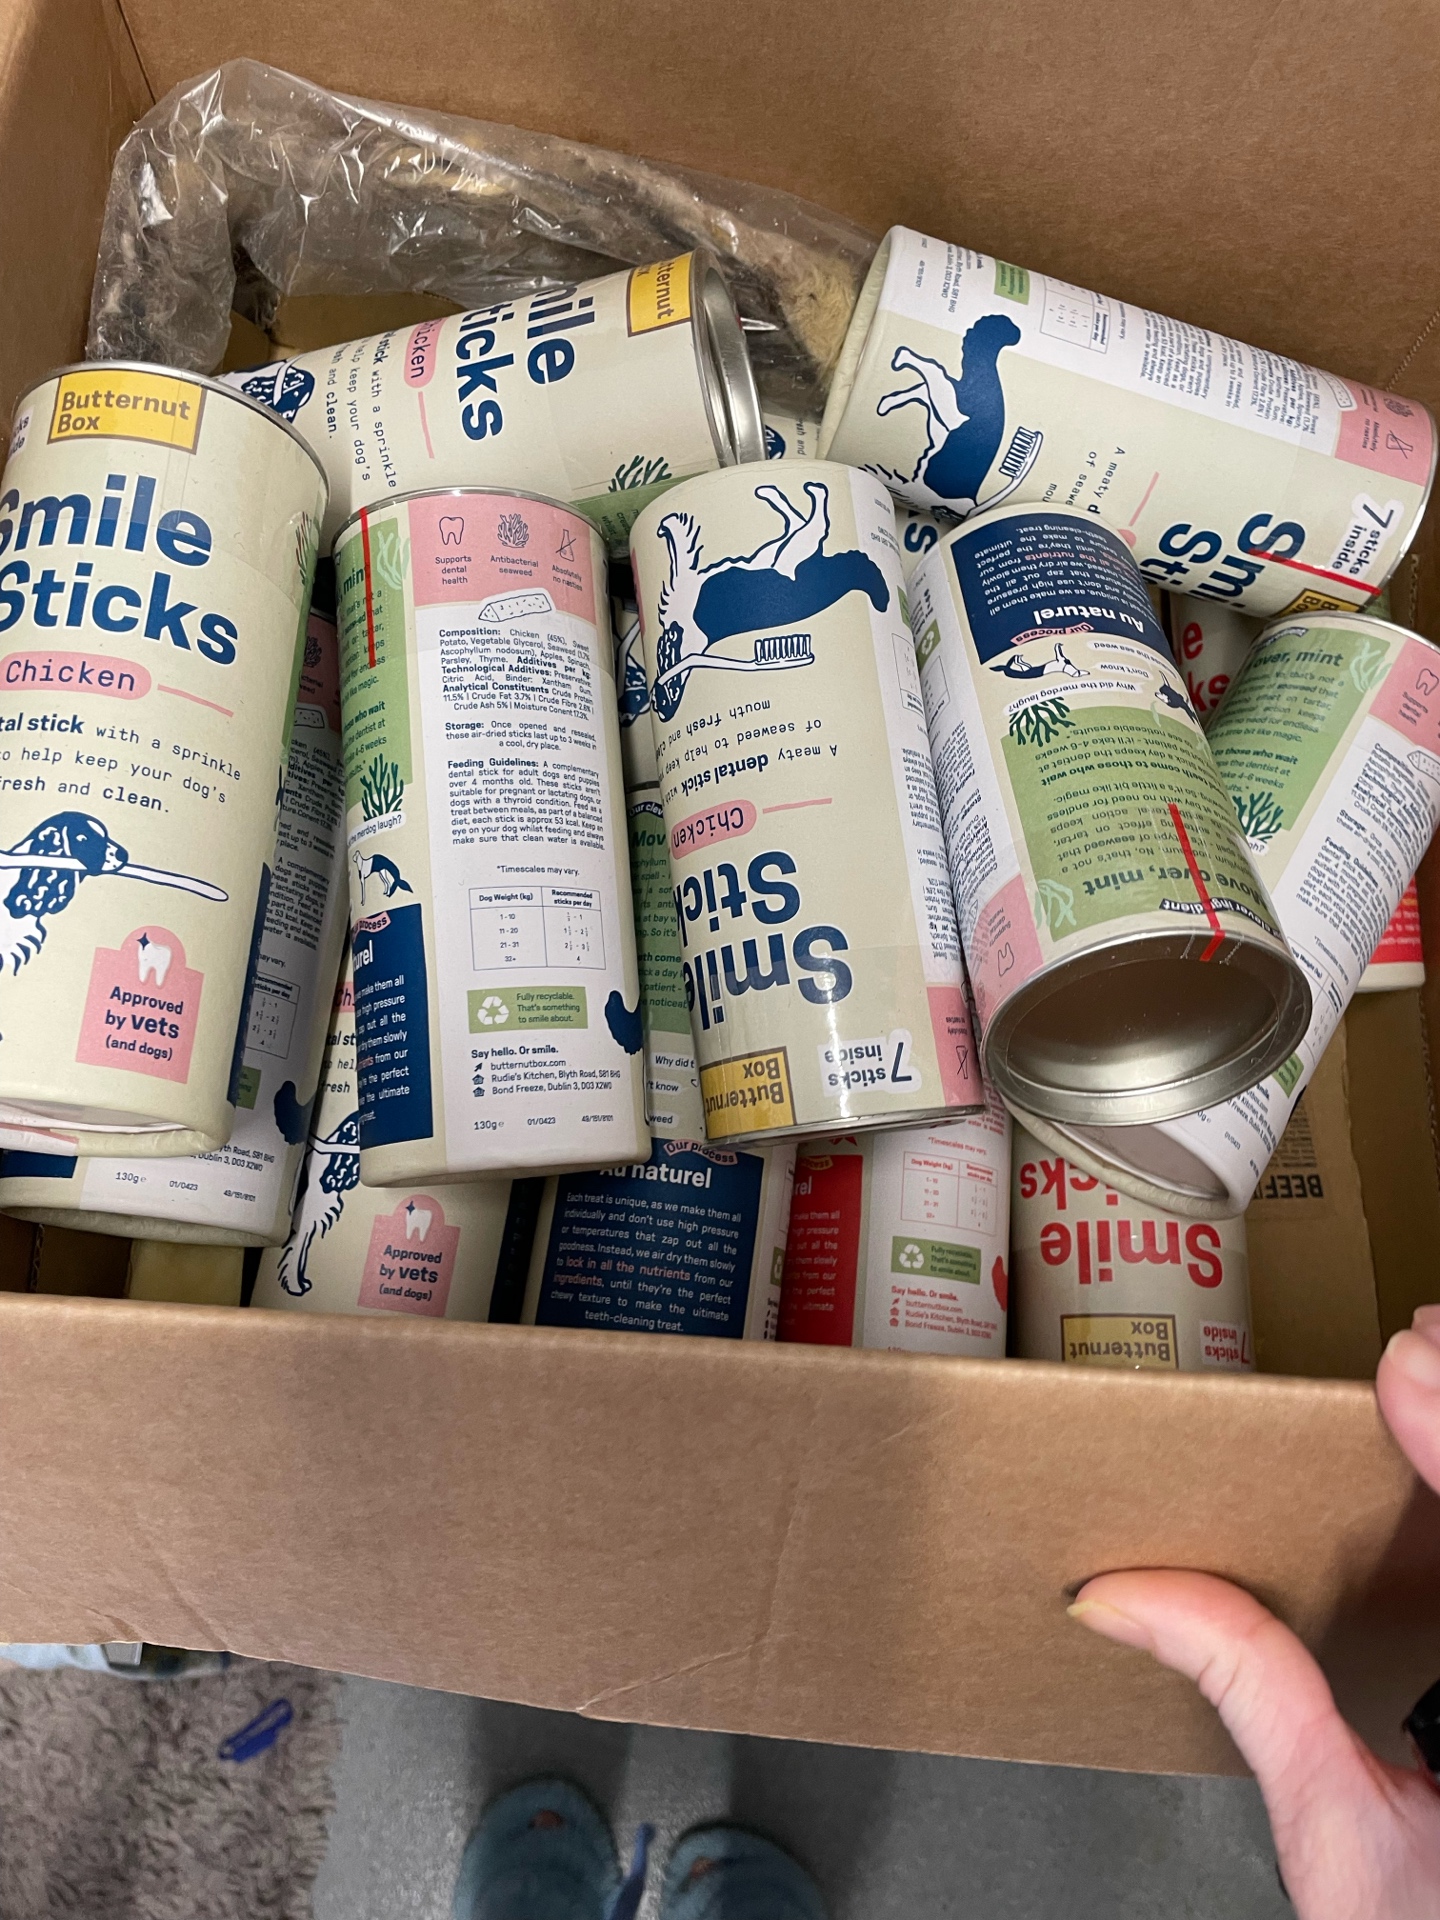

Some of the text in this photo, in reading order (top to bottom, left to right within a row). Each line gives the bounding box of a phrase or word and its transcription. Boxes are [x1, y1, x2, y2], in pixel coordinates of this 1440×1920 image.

[61, 390, 191, 420] Butternut
[57, 414, 100, 433] Box
[326, 392, 337, 439] clean.
[348, 367, 370, 481] keep your dog's
[371, 370, 396, 488] with sprinkle
[1094, 446, 1125, 499] A meaty
[1331, 524, 1359, 571] inside
[1348, 503, 1394, 575] 7 sticks
[435, 555, 472, 565] Supports
[490, 555, 539, 568] Antibacterial
[1190, 513, 1306, 609] Smi
[442, 566, 467, 574] dental
[499, 567, 532, 577] seaweed
[552, 565, 582, 582] Absolutely
[442, 576, 468, 585] health
[562, 577, 582, 591] nasties
[1033, 606, 1144, 633] Au naturel
[439, 628, 540, 639] Composition: Chicken
[470, 638, 510, 646] Vegetable
[513, 638, 545, 649] Glycerol,
[441, 656, 556, 668] Parsley, Additives
[1101, 664, 1124, 672] know
[1298, 650, 1343, 668] mint
[5, 660, 135, 691] Chicken
[442, 664, 552, 676] Technological Additives:
[443, 683, 549, 694] Analytical Constituents
[1008, 681, 1136, 713] Why did the merdog laugh?
[729, 699, 771, 719] mouth
[445, 721, 547, 731] Storage: Once opened
[687, 715, 722, 736] fresh
[27, 714, 241, 780] stick with a sprinkle
[684, 719, 822, 762] of seaweed to help
[448, 758, 539, 769] Feeding Guidelines:
[681, 744, 838, 797] A meaty dental stick
[21, 749, 226, 803] help keep your dog's
[58, 783, 90, 795] and
[103, 786, 169, 813] clean.
[672, 807, 744, 848] Chicken
[547, 867, 562, 875] may
[564, 868, 579, 876] vary.
[1082, 868, 1143, 896] mint
[479, 894, 493, 902] Dog
[520, 893, 533, 901] (kg)
[552, 890, 593, 899] Recommended
[554, 898, 592, 908] sticks per day
[109, 986, 184, 1015] Approved
[517, 993, 574, 1001] Fully recyclable.
[518, 1004, 580, 1013] That's something
[105, 1010, 180, 1039] by vets
[528, 1015, 549, 1023] smile
[105, 1035, 173, 1061] (and dogs)
[471, 1045, 559, 1059] Say hello. Or smile.
[490, 1059, 566, 1071] butternutbox.com
[743, 1057, 780, 1080] Box
[828, 1042, 912, 1089] 7 sticks
[492, 1072, 522, 1083] Rudie's
[524, 1071, 557, 1081] Kitchen,
[559, 1070, 578, 1080] Blyth
[579, 1069, 597, 1079] Road,
[492, 1084, 513, 1095] Bond
[516, 1083, 546, 1093] Freeze,
[548, 1082, 572, 1092] Dublin
[573, 1083, 580, 1091] 3,
[706, 1081, 784, 1117] Butternut
[474, 1121, 497, 1131] 130g
[527, 1117, 556, 1126] 01/0423
[666, 1142, 689, 1153] Our
[115, 1171, 139, 1185] 130g
[632, 1163, 712, 1189] naturel
[169, 1180, 198, 1191] 01/0423
[585, 1194, 730, 1221] treat unique, make them
[608, 1211, 739, 1239] and don't high pressure
[384, 1245, 442, 1264] Approved
[1040, 1220, 1223, 1288] Smile
[379, 1264, 438, 1283] by vets
[640, 1264, 691, 1281] nutrients
[379, 1283, 432, 1301] (and dogs)
[585, 1309, 684, 1332] teeth-cleaning treat.
[1131, 1321, 1168, 1341] Box
[1203, 1326, 1237, 1342] inside
[1070, 1341, 1171, 1362] Butternut
[1205, 1345, 1239, 1361] sticks
